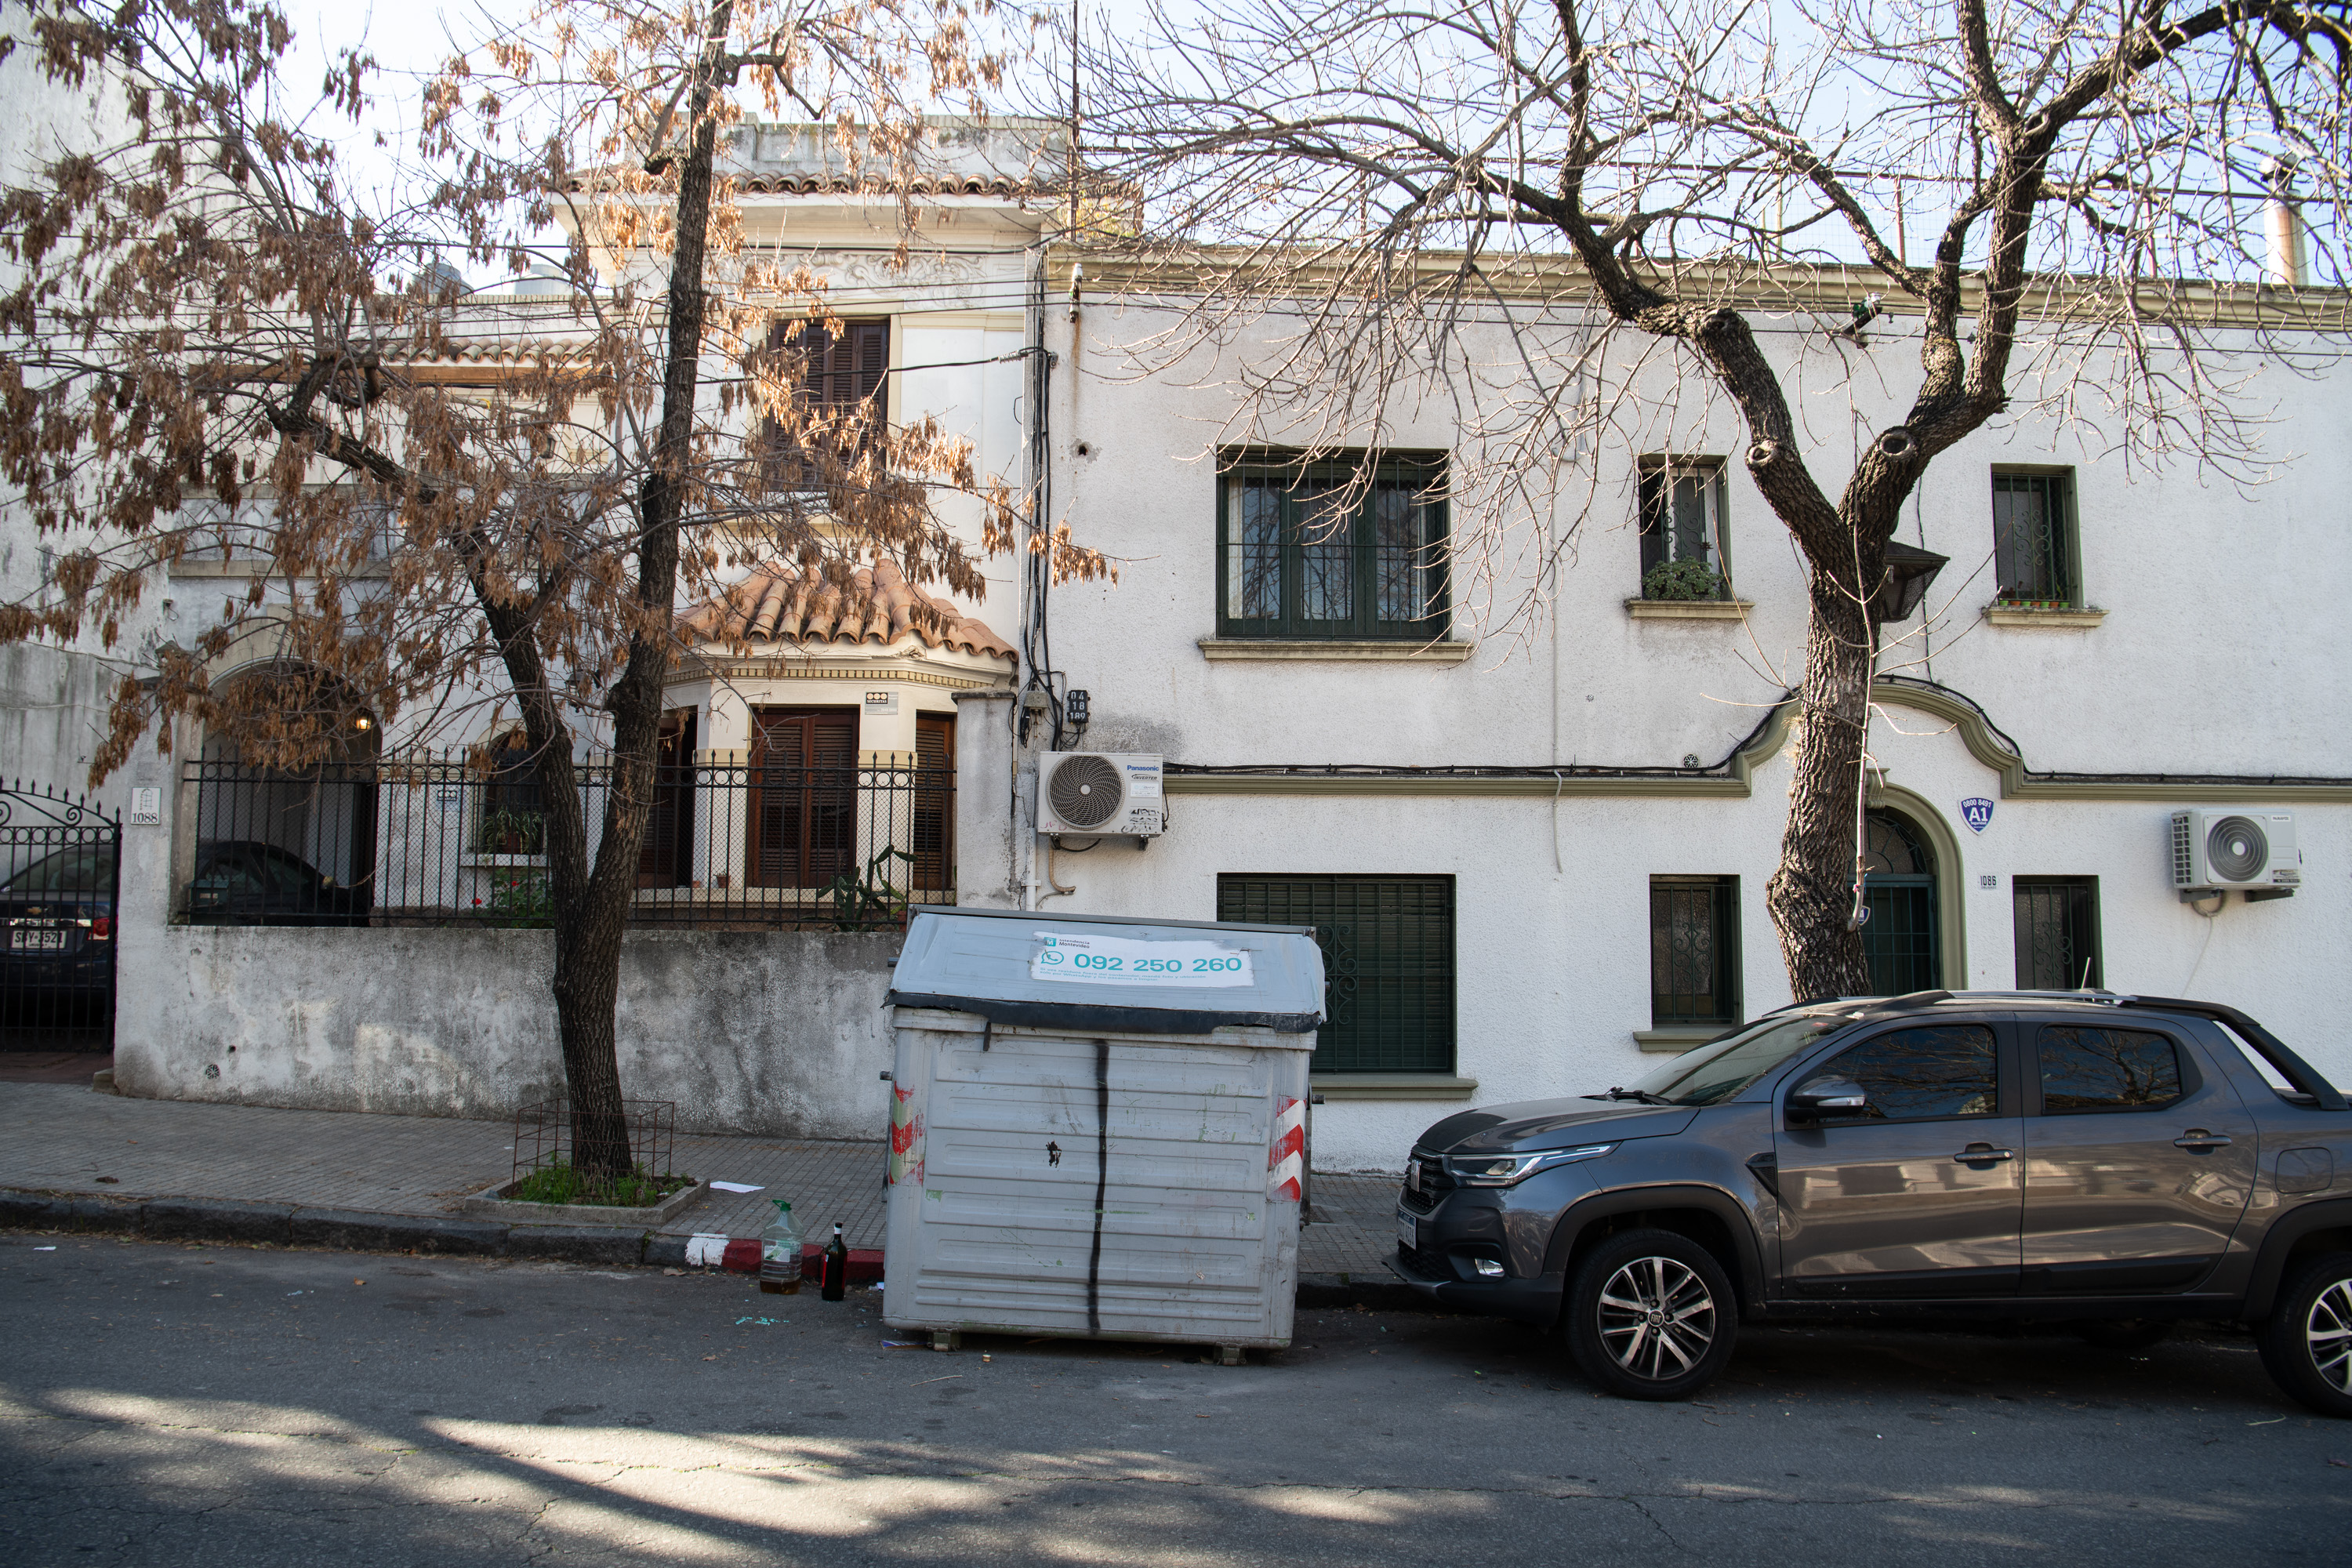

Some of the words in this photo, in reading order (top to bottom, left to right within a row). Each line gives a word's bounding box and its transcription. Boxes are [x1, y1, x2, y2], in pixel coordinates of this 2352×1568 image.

[1070, 712, 1086, 720] 189
[1963, 799, 1976, 808] 0800
[1978, 799, 1991, 808] 8491
[132, 812, 158, 823] 1088
[1969, 807, 1988, 822] A1
[1980, 875, 1997, 886] 1086
[1074, 953, 1123, 971] 092
[1133, 959, 1182, 972] 250
[1192, 957, 1242, 972] 260
[1650, 1313, 1662, 1323] FIAT
